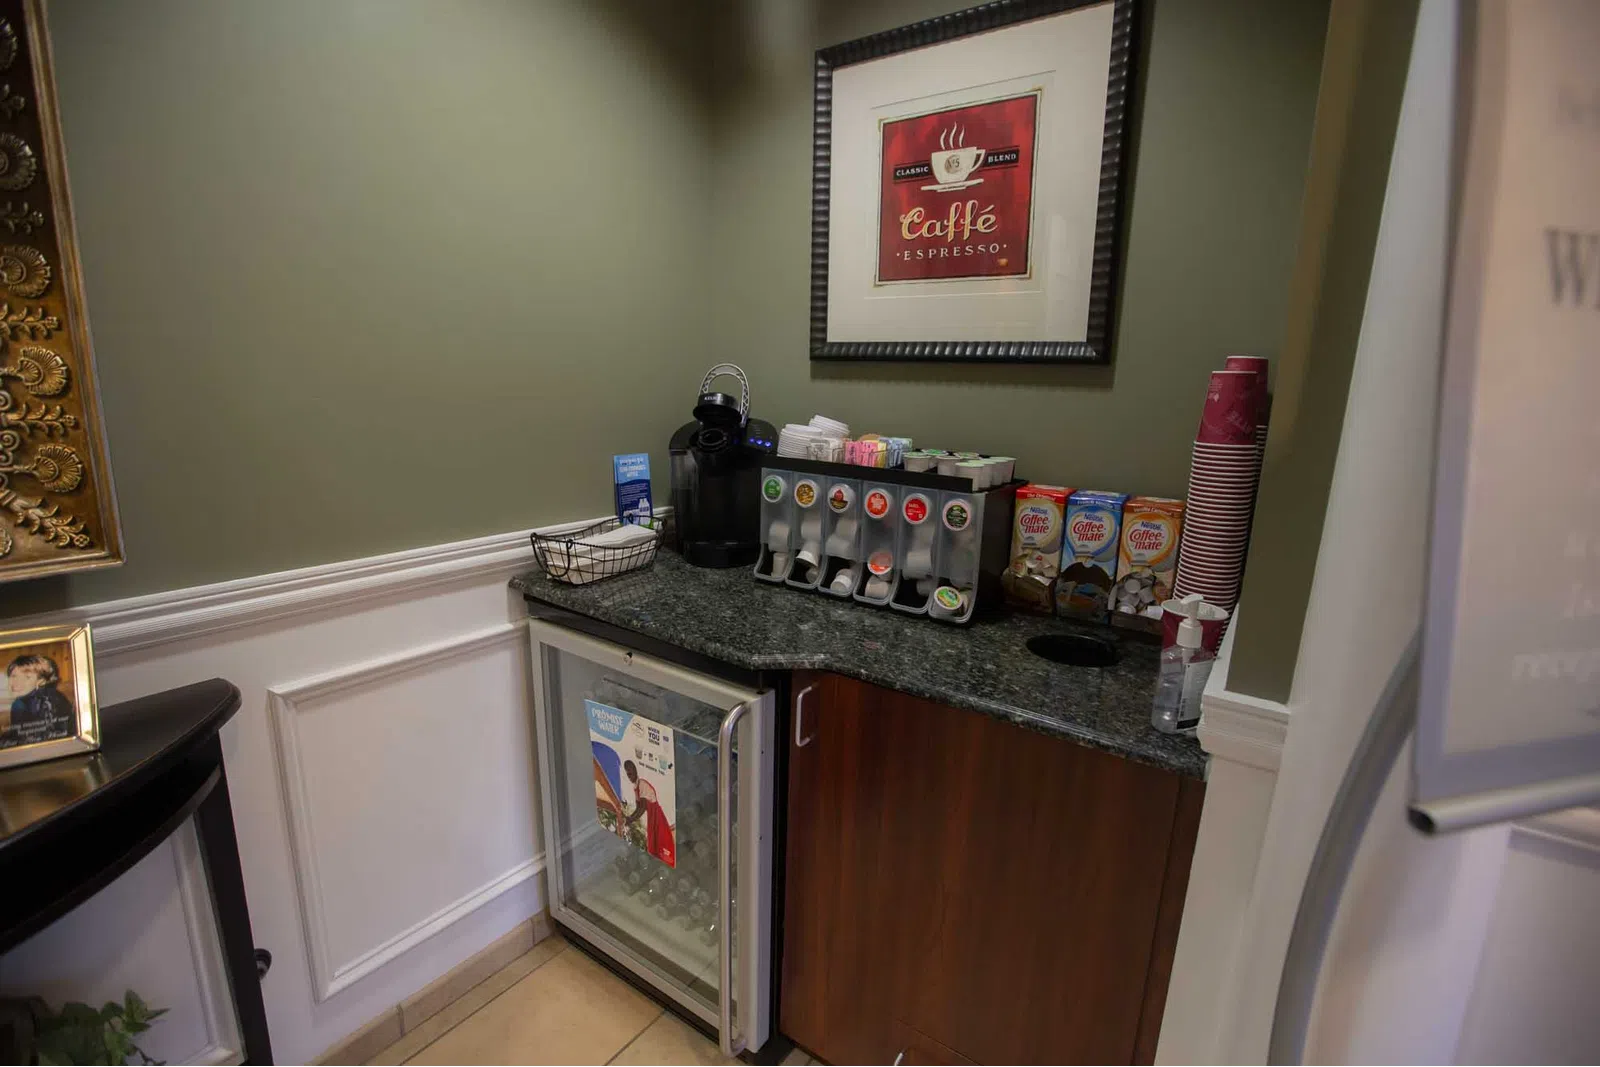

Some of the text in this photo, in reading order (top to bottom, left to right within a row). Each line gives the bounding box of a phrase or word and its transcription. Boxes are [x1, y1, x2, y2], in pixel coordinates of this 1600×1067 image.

[896, 153, 1017, 176] CLASSIC BLEND
[900, 200, 999, 242] Caffé
[904, 243, 1000, 261] ESPRESSO
[1025, 525, 1049, 534] mate
[1078, 532, 1104, 541] mate
[1135, 540, 1163, 550] mate
